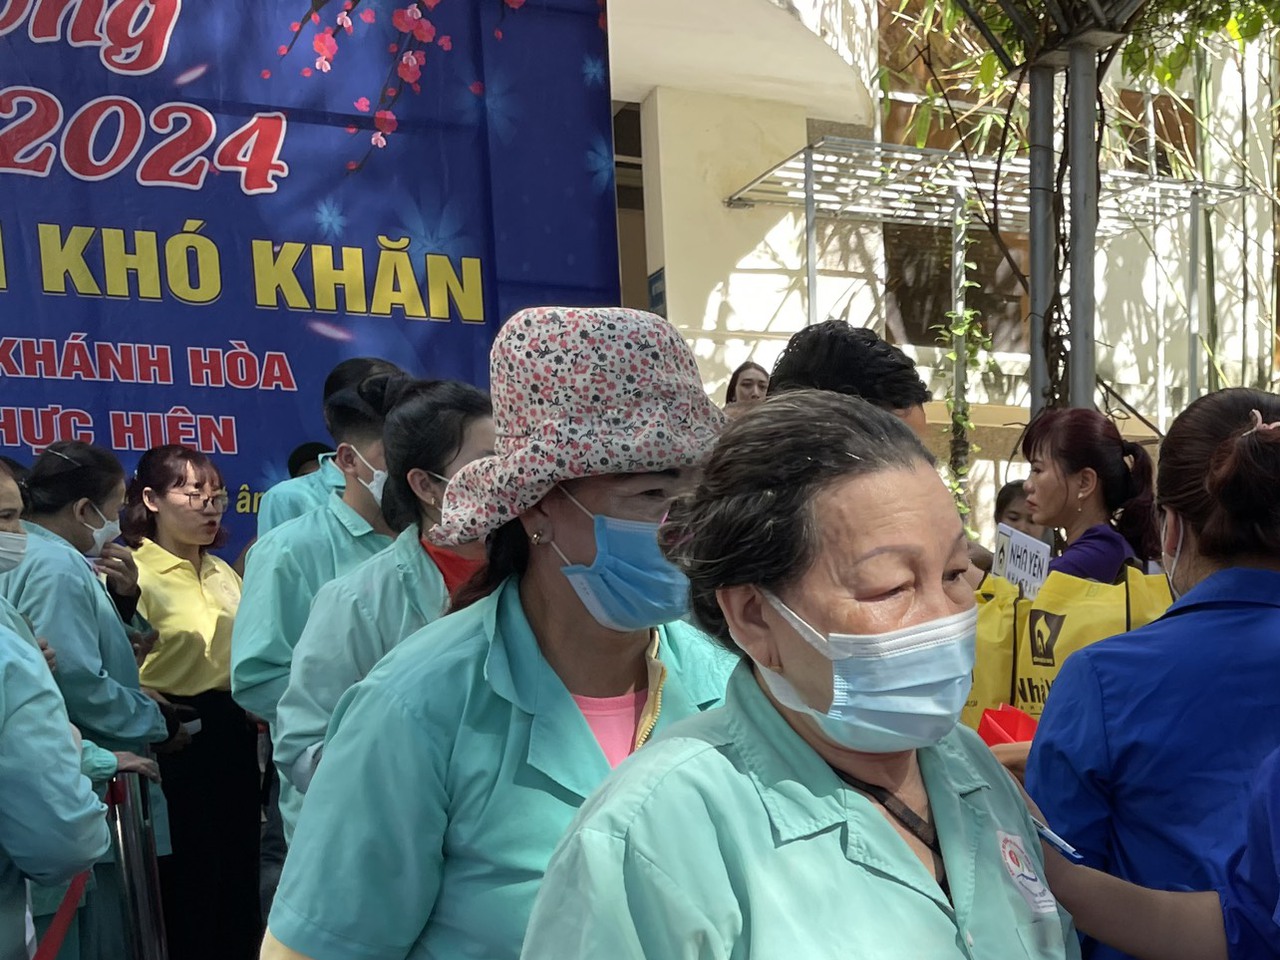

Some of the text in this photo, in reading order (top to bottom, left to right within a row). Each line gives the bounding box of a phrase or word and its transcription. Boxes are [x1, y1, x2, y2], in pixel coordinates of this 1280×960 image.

[0, 86, 288, 195] 2024
[37, 219, 222, 304] KHÓ
[250, 235, 486, 324] KHĂN
[188, 340, 298, 391] HÒA
